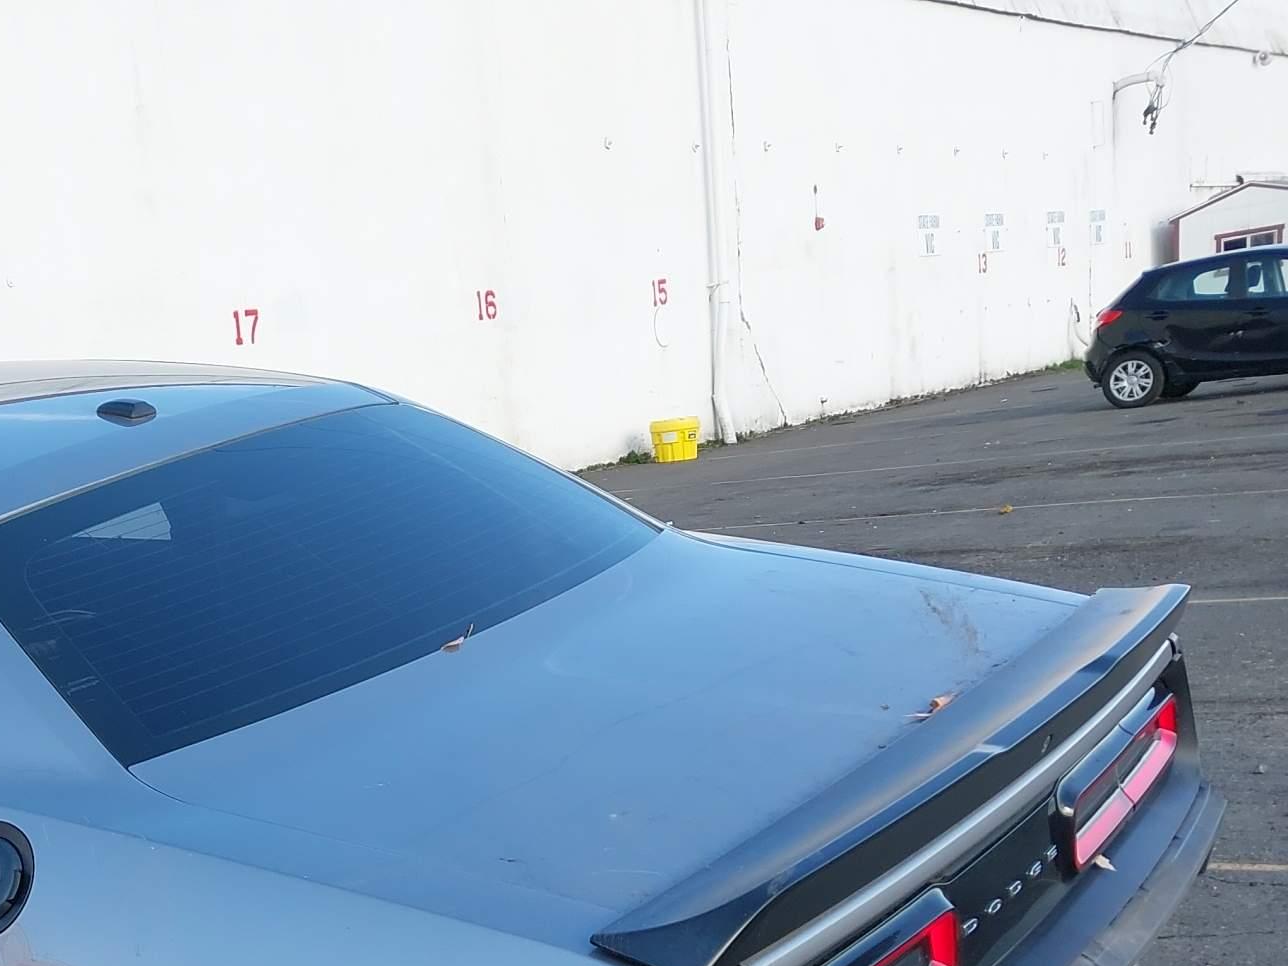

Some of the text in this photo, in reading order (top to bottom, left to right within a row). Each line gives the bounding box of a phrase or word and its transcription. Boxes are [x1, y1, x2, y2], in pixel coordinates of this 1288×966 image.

[978, 253, 988, 274] 13
[1057, 247, 1066, 267] 12
[476, 290, 497, 321] 16
[651, 278, 668, 307] 15
[232, 308, 260, 346] 17
[962, 845, 1058, 936] DODGE
